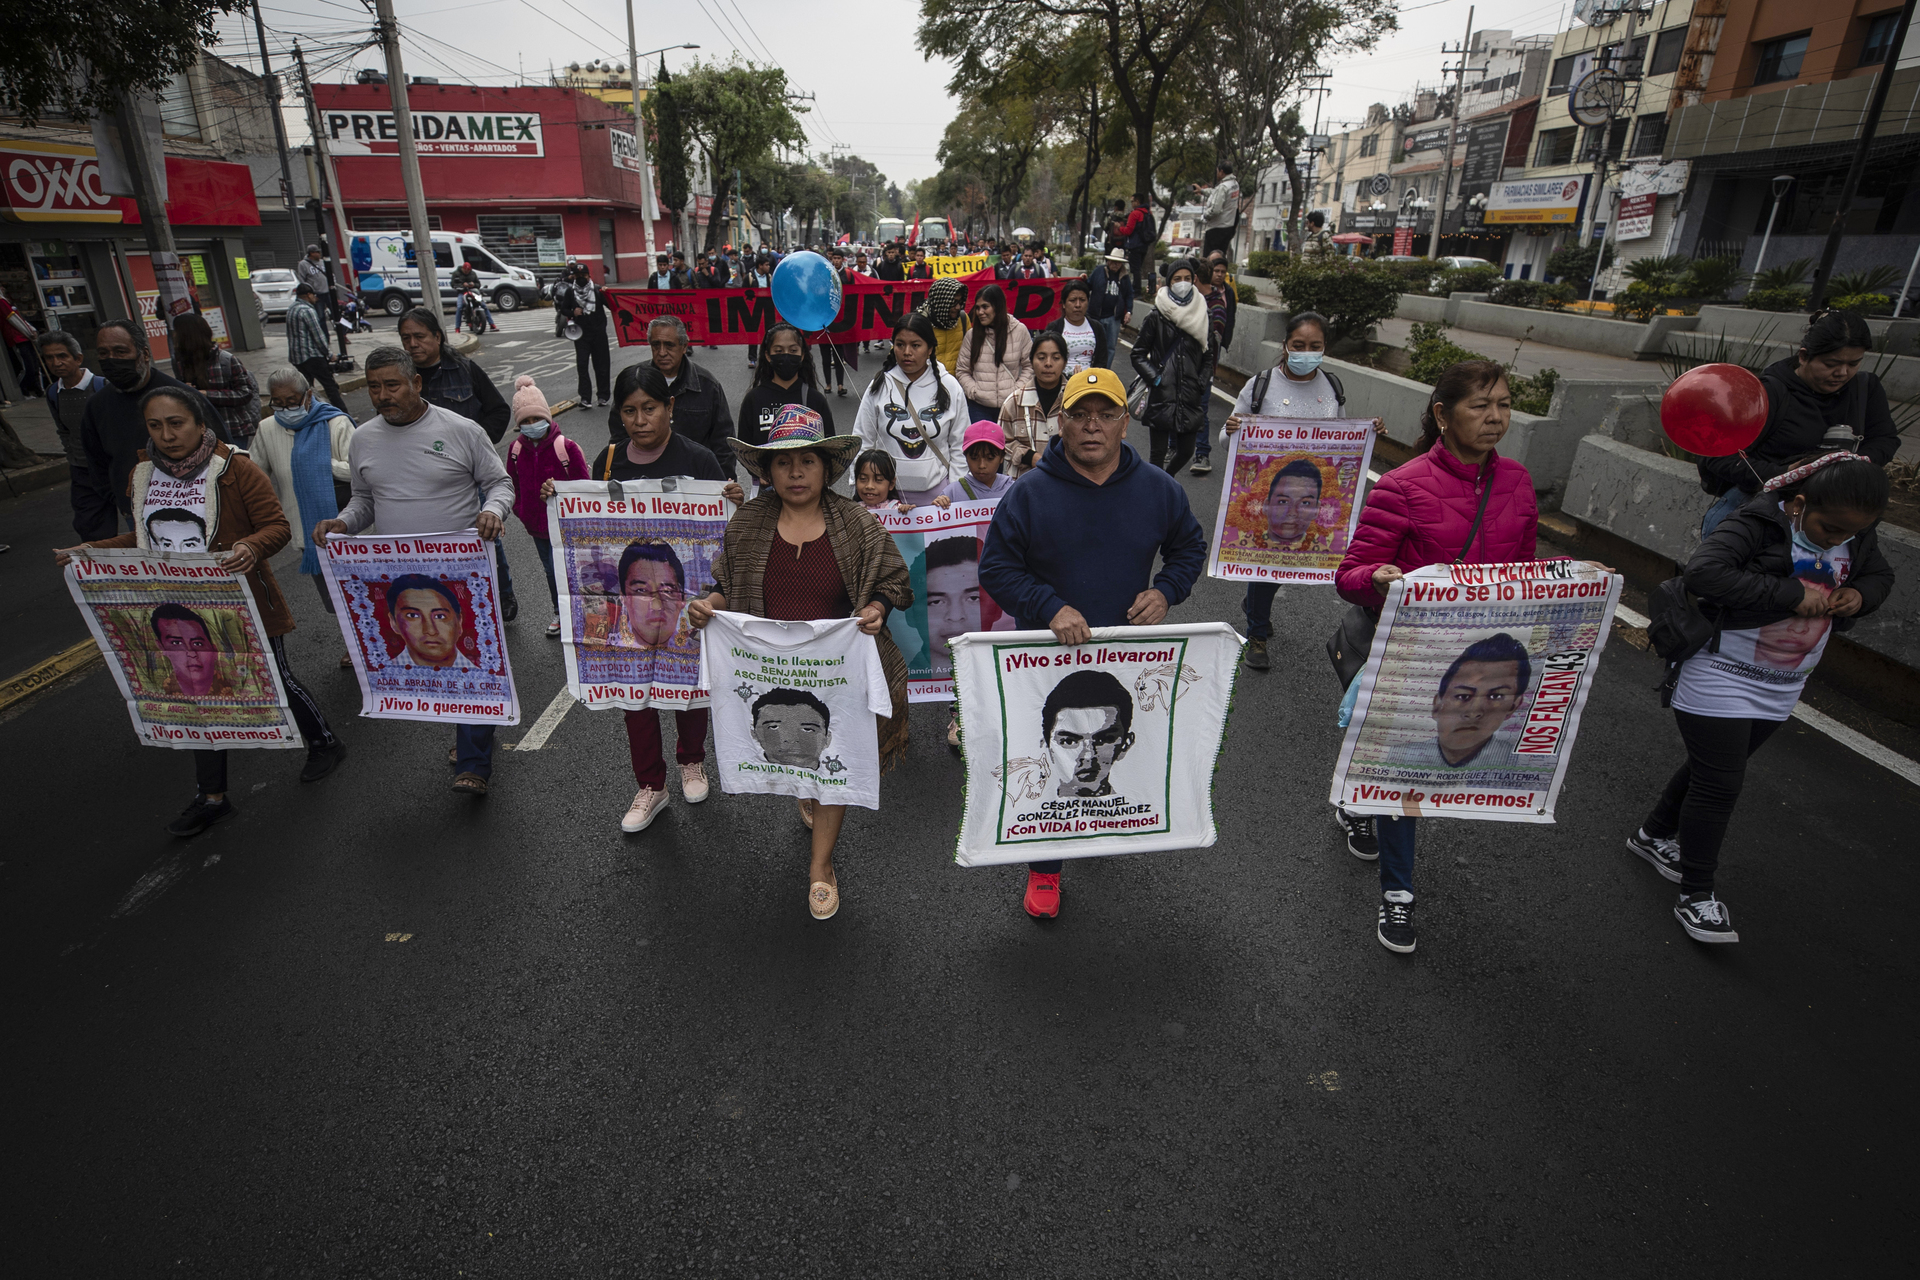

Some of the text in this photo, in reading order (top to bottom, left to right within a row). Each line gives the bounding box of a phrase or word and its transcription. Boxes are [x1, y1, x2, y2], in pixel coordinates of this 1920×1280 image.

[415, 143, 517, 153] EÑOS VENTAS APARTADOS
[9, 159, 111, 208] OXXO
[1504, 181, 1563, 197] FARMACIAS SIMILARES
[936, 258, 985, 275] ierno
[634, 303, 696, 315] AYOTZINAPA
[706, 285, 1055, 334] IMUNID
[1081, 349, 1093, 357] 43
[1241, 426, 1367, 441] ¡Vivo se lo llevaron!
[161, 481, 182, 489] se lo
[175, 496, 205, 506] CANTO
[560, 497, 724, 517] ¡Vivo se lo llevaron!
[916, 514, 933, 524] se
[938, 510, 951, 522] lo
[955, 506, 996, 519] llevar
[327, 539, 483, 559] ¡Vivo se lo llevaron!
[75, 561, 230, 579] ¡Vivo se lo llevaron!
[1223, 564, 1335, 581] ¡Vivo lo queremos!
[1404, 577, 1607, 606] ¡Vivo se lo llevaron!
[1400, 610, 1411, 619] Yo,
[1415, 610, 1428, 618] Jan
[1430, 610, 1453, 619] Nimmo,
[1457, 610, 1487, 619] Glasgow,
[1490, 609, 1519, 618] Escocia,
[1523, 608, 1544, 617] quiero
[1547, 607, 1564, 616] saber
[731, 647, 844, 666] ¡Vivo se lo llevaron!
[1006, 647, 1175, 672] ¡Vivo se lo llevaron!
[23, 663, 62, 687] CDMX
[589, 661, 698, 674] ANTONIO SANTANA MAE
[761, 666, 818, 678] BENJAMÍN
[908, 666, 933, 675] jamín
[377, 677, 399, 686] ADÁN
[405, 678, 442, 688] ABRAJÁN
[447, 681, 458, 689] DE
[464, 682, 474, 690] LA
[734, 669, 848, 688] ASCENCIO BAUTISTA
[588, 686, 625, 702] ¡Vivo
[630, 686, 644, 700] lo
[915, 685, 941, 694] vida
[143, 702, 272, 715] JOSÉ ÁNGEL CAMPOS CANTOR
[379, 697, 504, 716] ¡Vivo lo queremos!
[1519, 671, 1579, 754] NOS FALTAN
[152, 725, 282, 743] ¡Vivo lo queremos!
[738, 761, 847, 786] ¡Con VIDA lo queremos!
[1359, 766, 1540, 781] JESÚS JOVANY RODRÍGUEZ TLATEMPA
[1041, 796, 1129, 811] CÉSAR MANUEL
[1352, 785, 1534, 808] ¡Vivo lo queremos!
[1017, 803, 1151, 822] GONZÁLEZ HERNÁNDEZ
[1006, 814, 1159, 839] ¡Con VIDA lo queremos!
